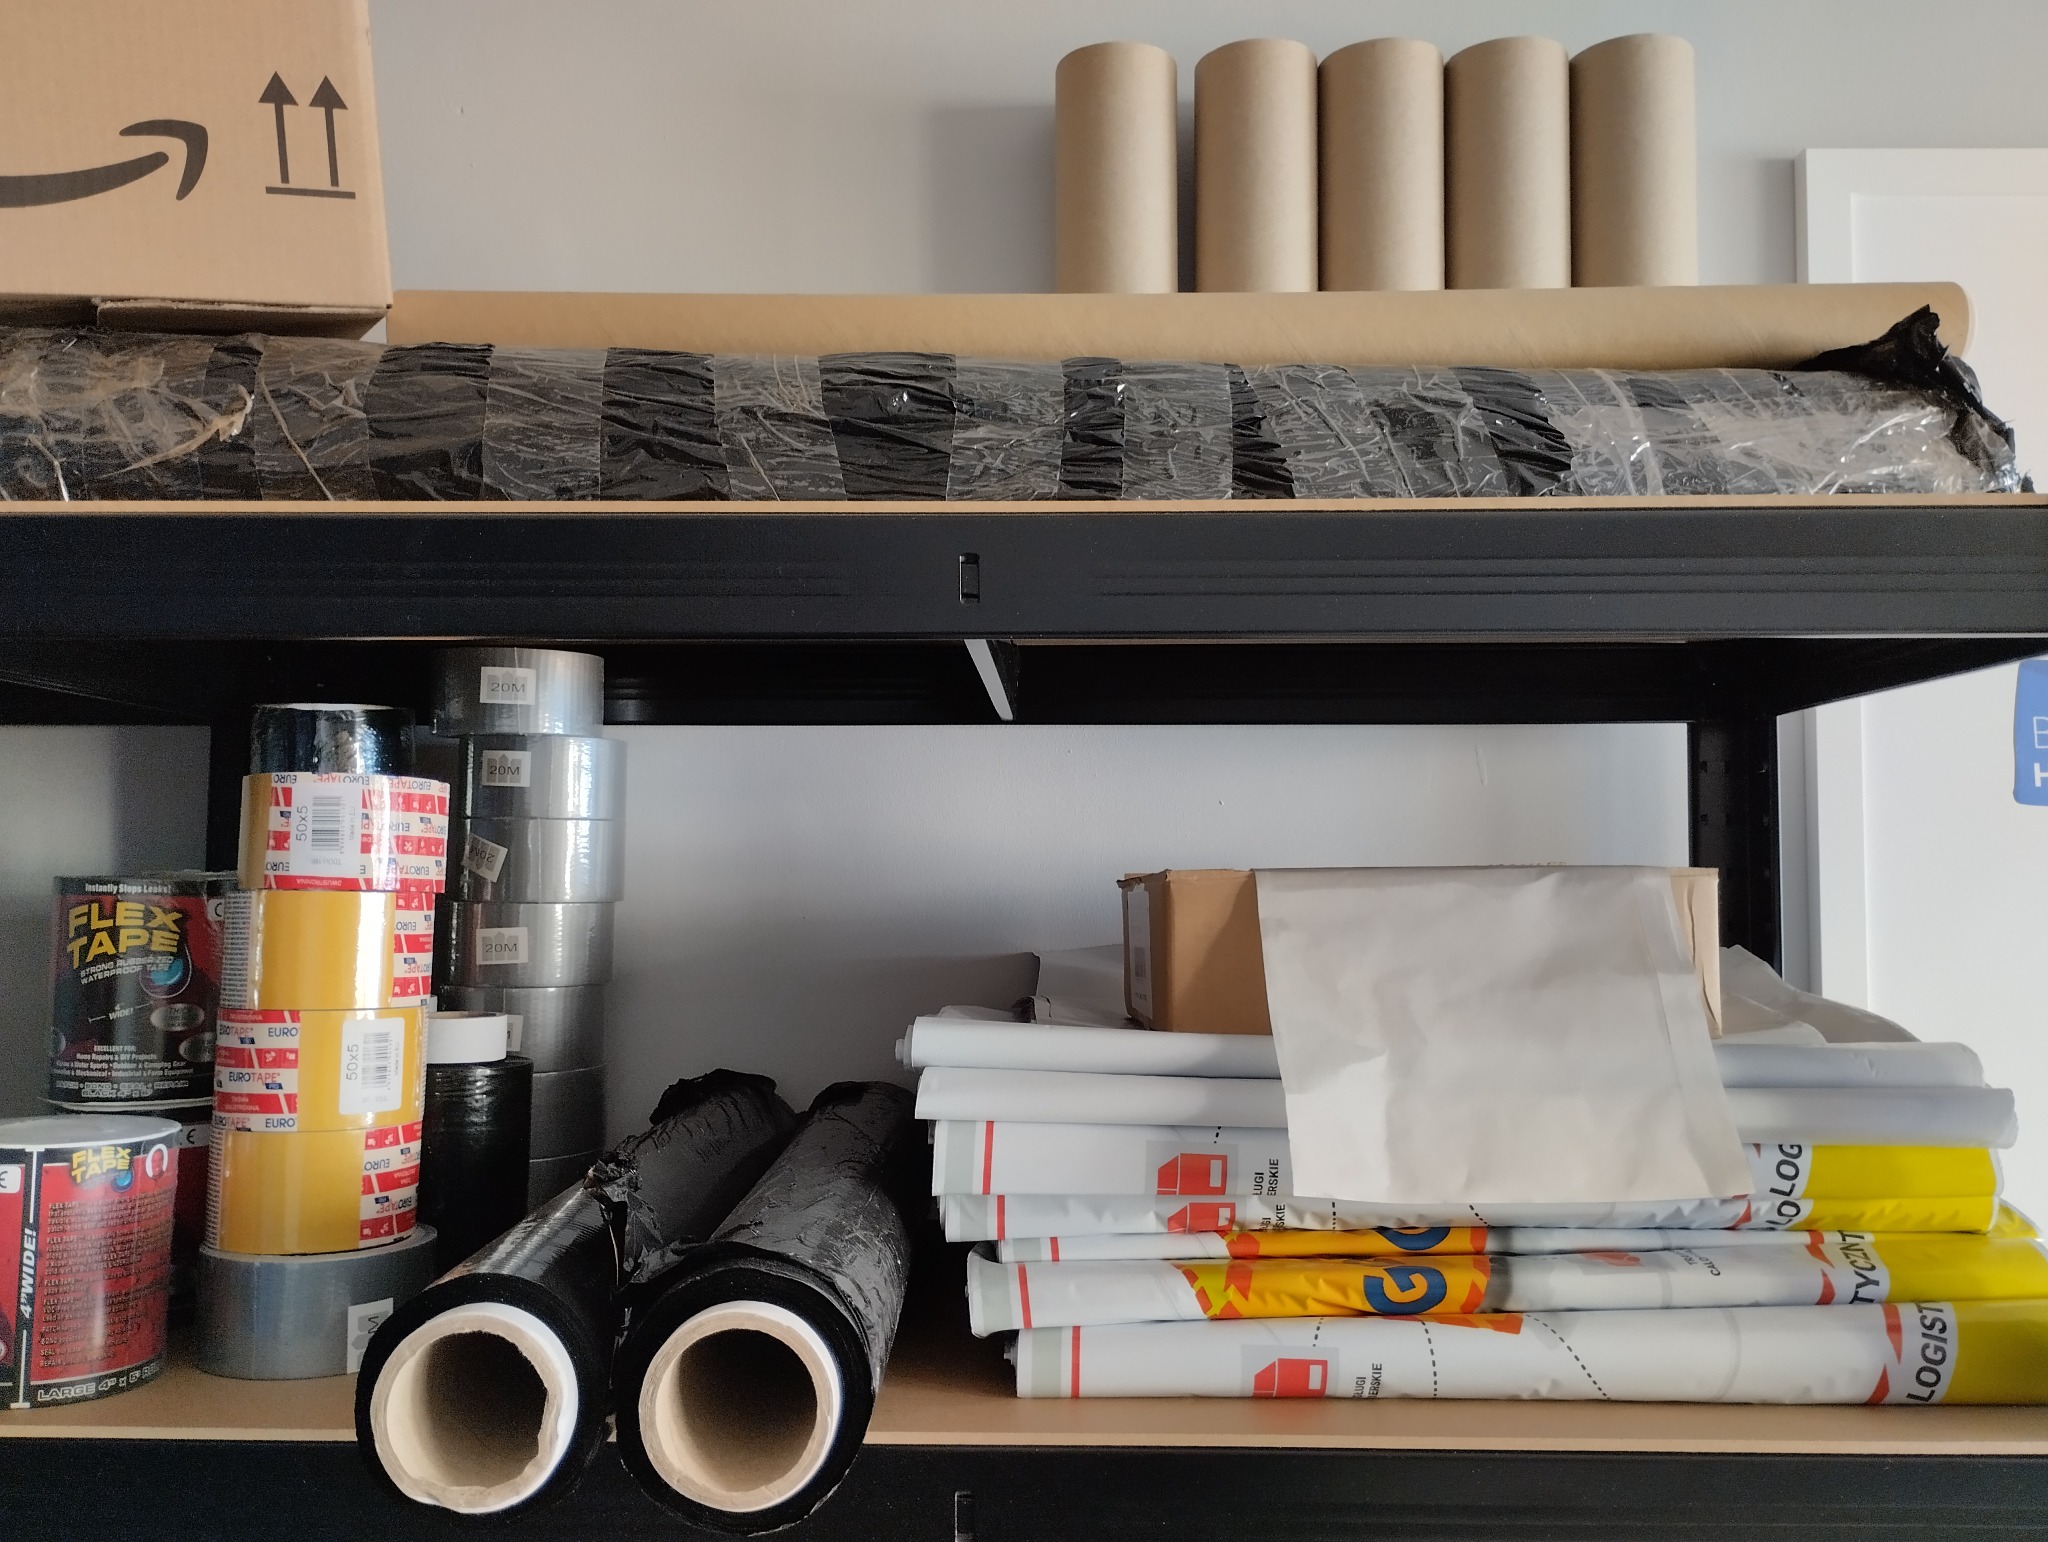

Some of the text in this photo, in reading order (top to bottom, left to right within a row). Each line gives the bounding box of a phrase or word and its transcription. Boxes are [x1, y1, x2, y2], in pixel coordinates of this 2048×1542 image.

[490, 682, 526, 693] 20M
[489, 765, 521, 776] 20M
[295, 805, 309, 842] 50x5
[85, 883, 172, 894] Instantly Stops Leaks!
[68, 901, 183, 938] FLEX
[66, 928, 180, 970] TAPE
[484, 942, 518, 954] 20M
[80, 961, 114, 978] STRONG
[80, 965, 143, 985] WATERPROOF
[108, 1007, 135, 1020] WIDE!
[268, 1027, 299, 1037] EURO
[345, 1044, 359, 1081] 50x5
[228, 1071, 281, 1083] EUROTAPE
[265, 1118, 296, 1129] EURO
[72, 1146, 132, 1169] FLEX
[364, 1159, 391, 1171] EURO
[71, 1159, 130, 1184] TAPE
[1769, 1144, 1803, 1197] LOG
[1906, 1302, 1948, 1402] LOGIST
[38, 1382, 96, 1402] LARGE
